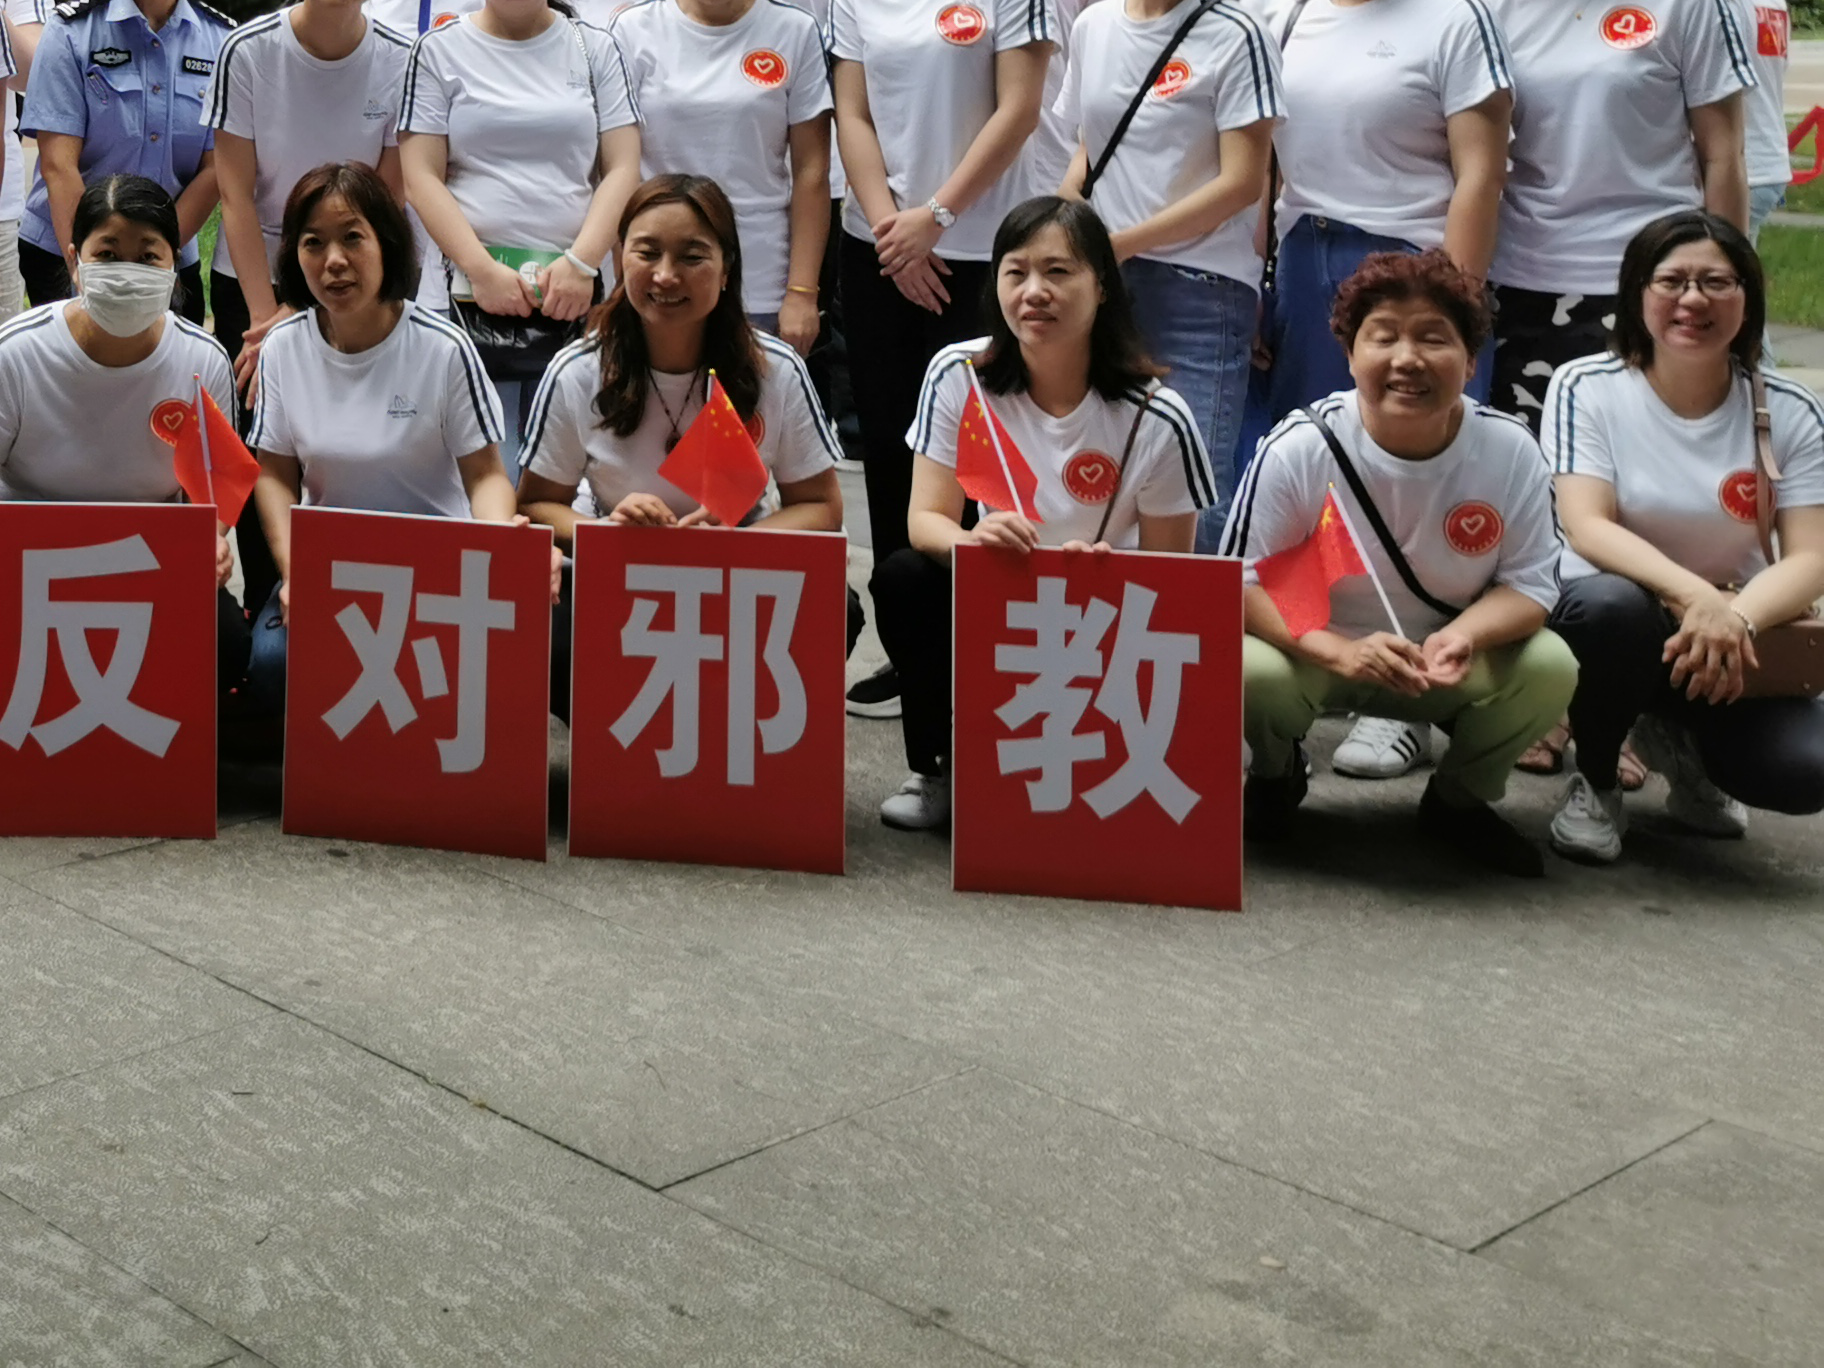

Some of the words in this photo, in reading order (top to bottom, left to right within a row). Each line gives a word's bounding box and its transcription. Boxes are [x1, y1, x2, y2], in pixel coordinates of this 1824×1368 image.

[321, 549, 516, 773] 对
[609, 563, 808, 787] 邪
[994, 576, 1202, 825] 教
